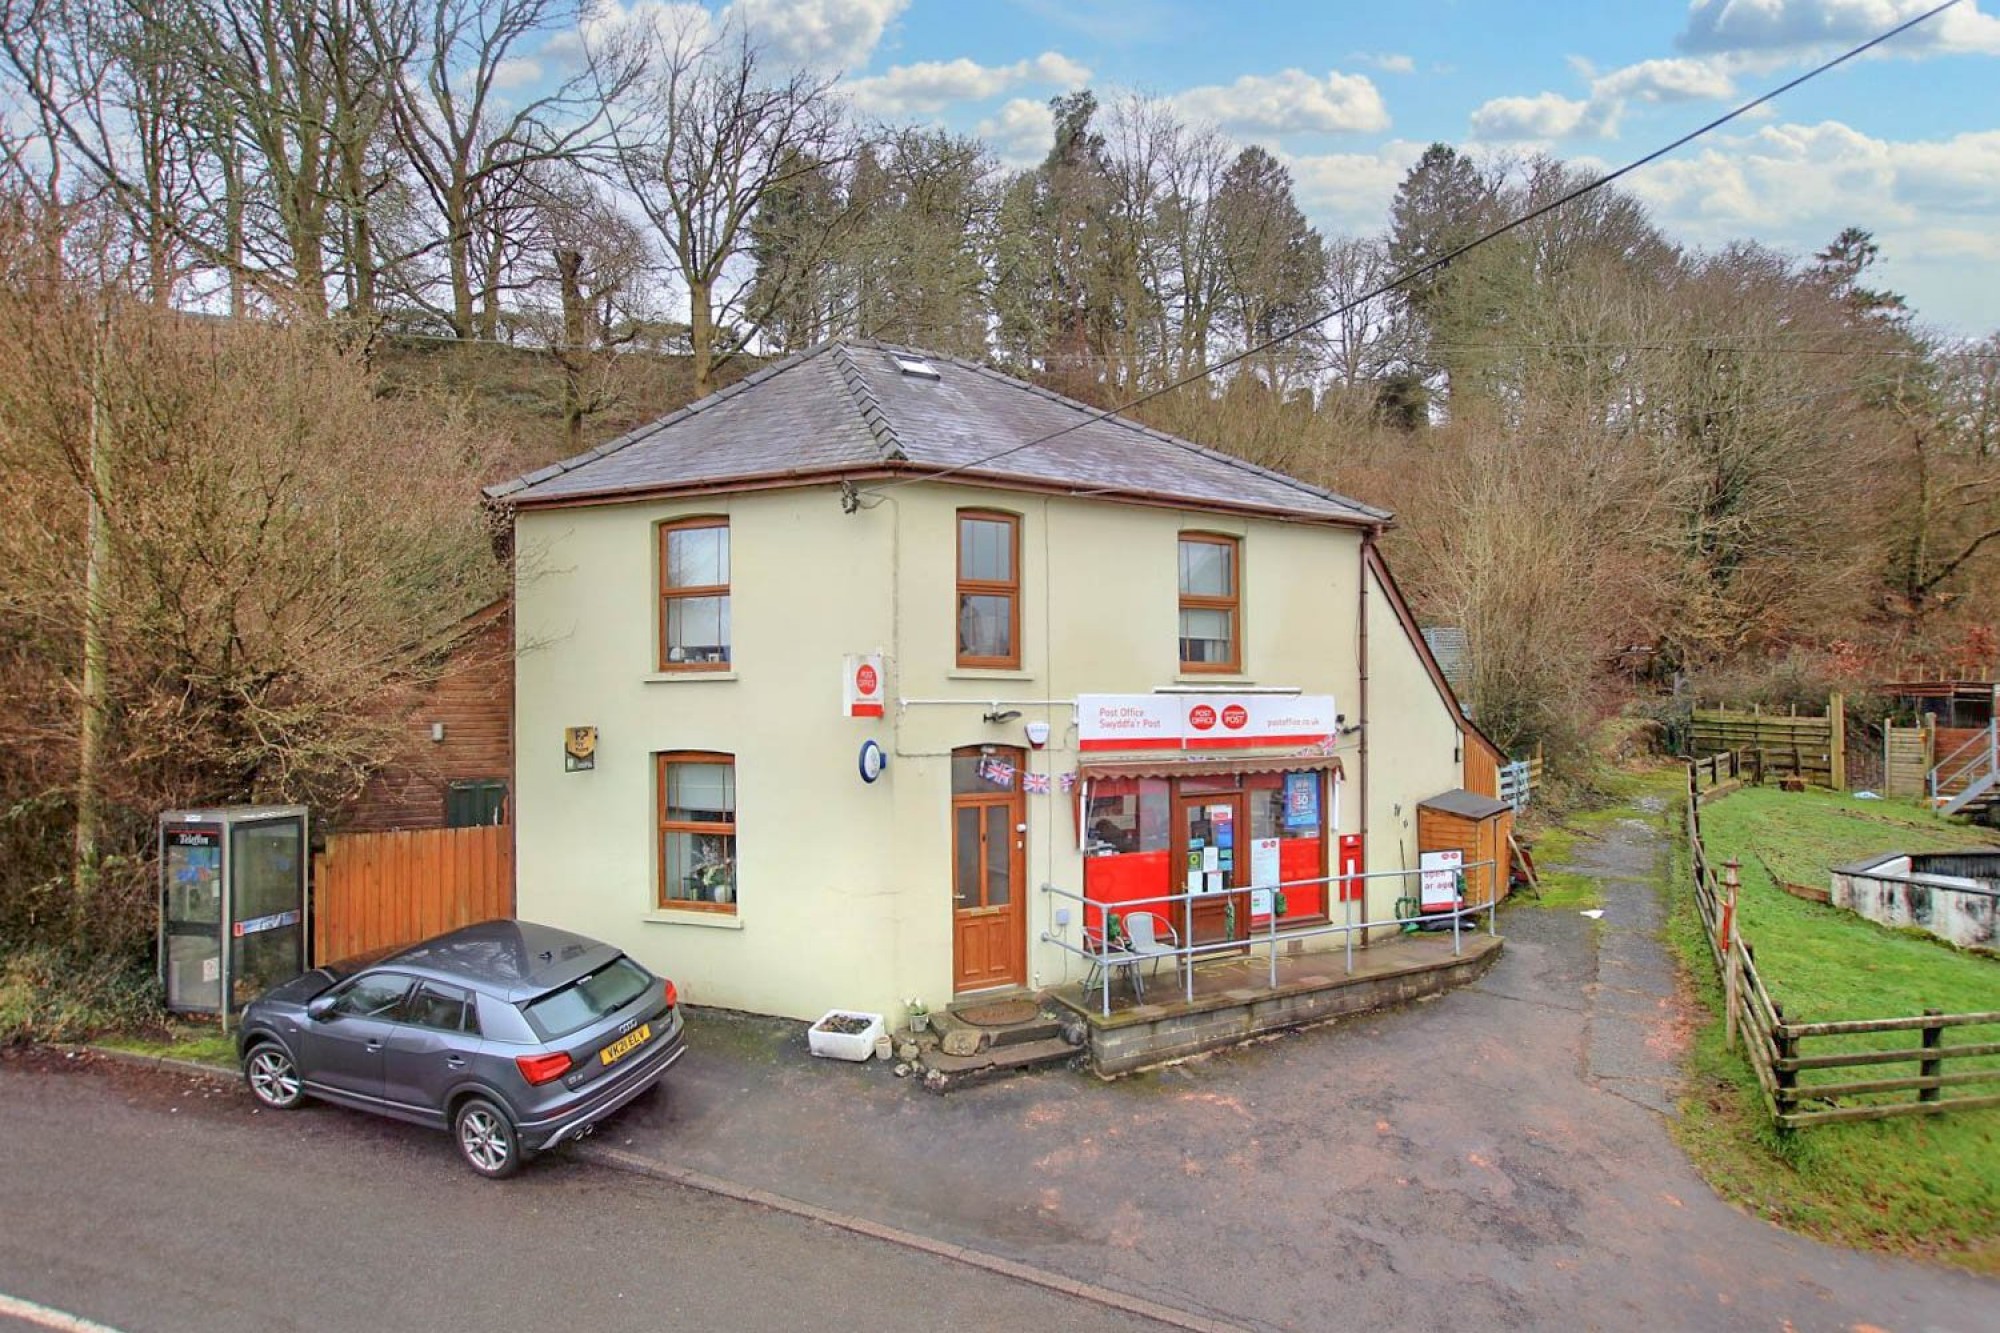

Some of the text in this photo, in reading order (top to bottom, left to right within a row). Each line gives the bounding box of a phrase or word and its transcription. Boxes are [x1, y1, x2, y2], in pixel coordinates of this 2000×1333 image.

[1099, 706, 1144, 717] Post Office
[1195, 709, 1212, 717] POST
[1143, 718, 1161, 729] Post
[1191, 716, 1213, 725] OFFICE
[1226, 716, 1244, 725] POST
